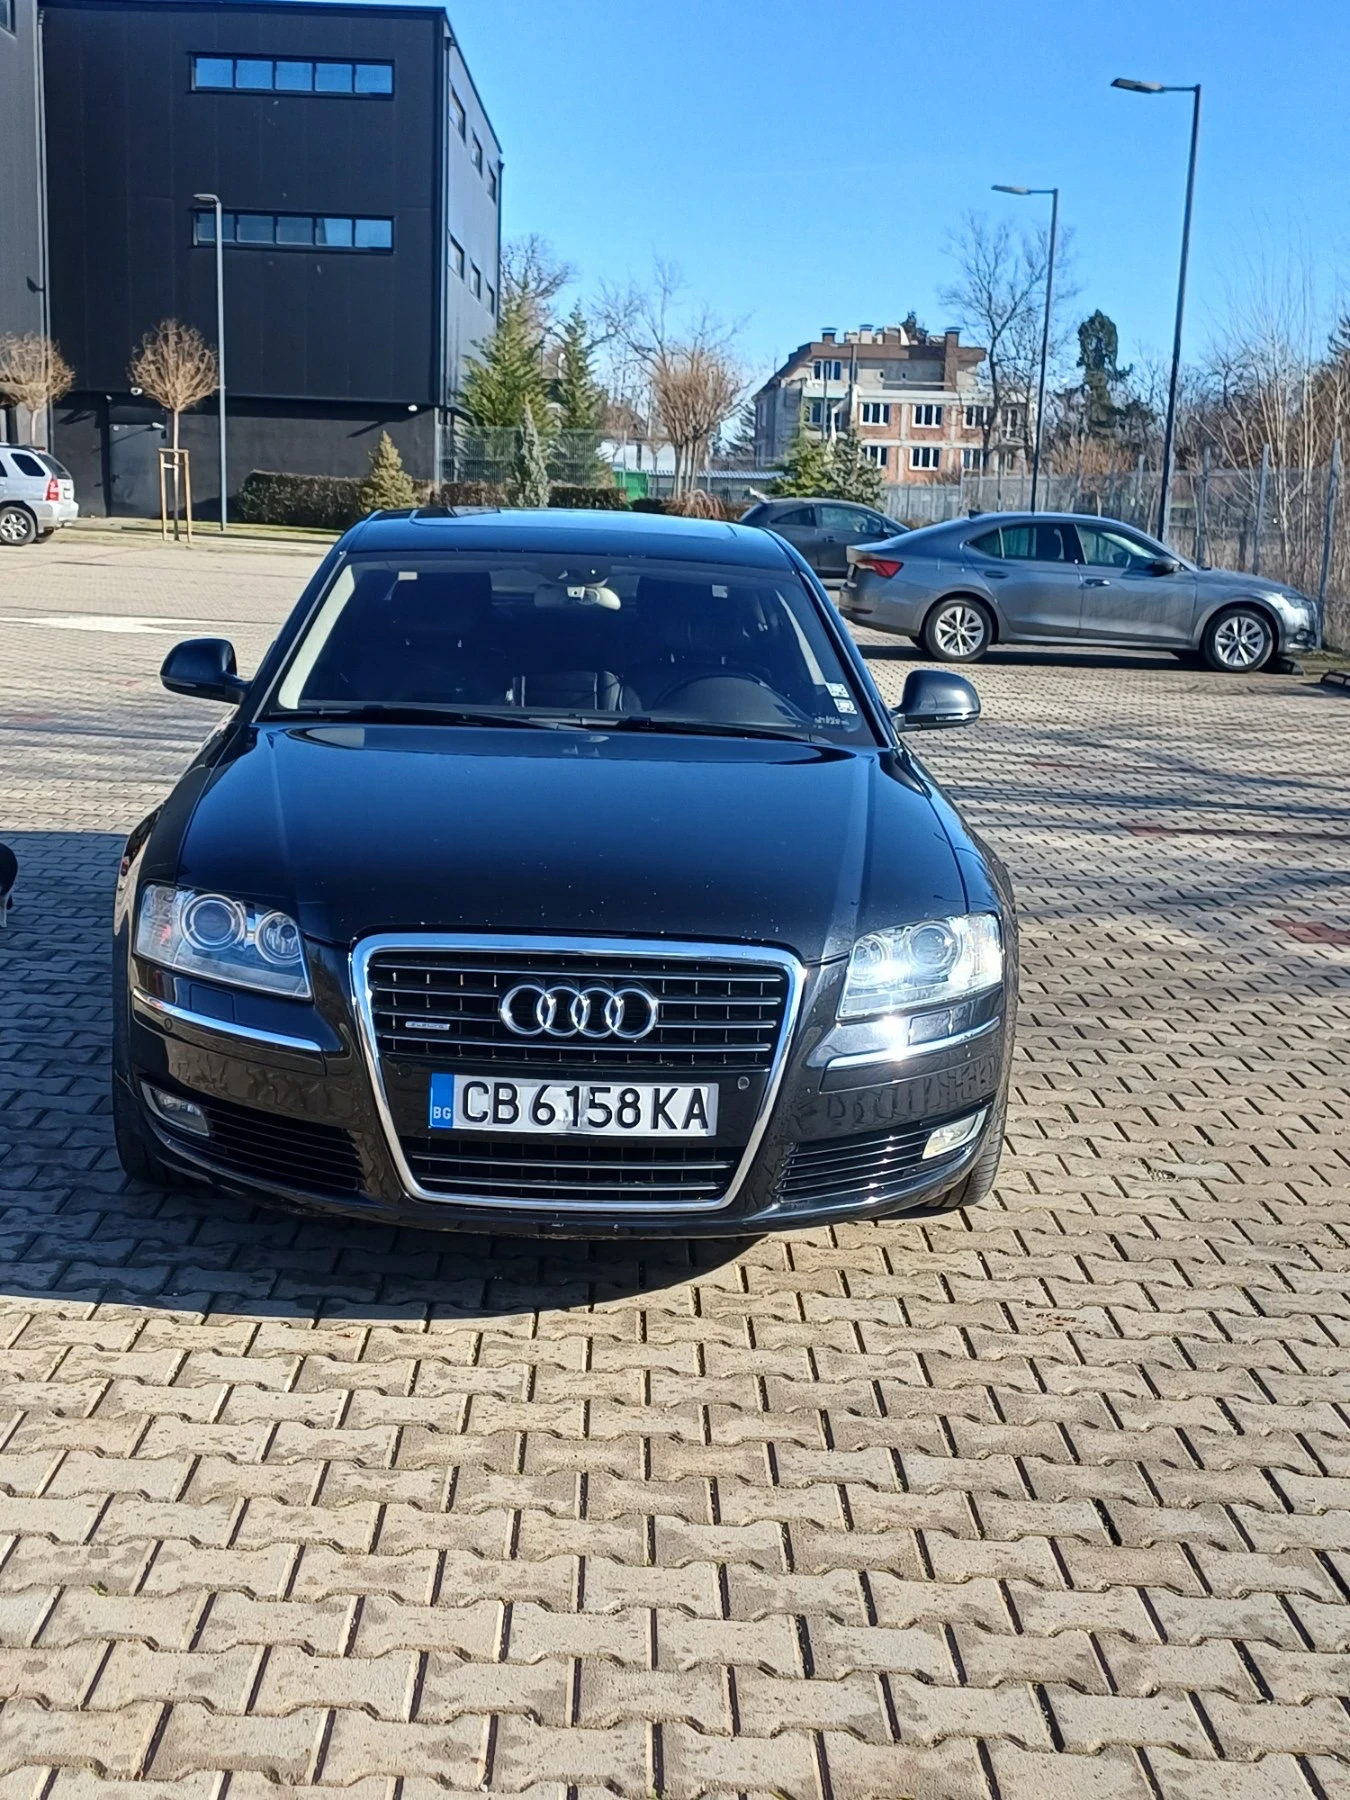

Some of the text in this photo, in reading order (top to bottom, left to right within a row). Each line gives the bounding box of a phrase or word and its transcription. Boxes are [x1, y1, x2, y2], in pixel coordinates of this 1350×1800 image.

[433, 1106, 452, 1120] BG
[462, 1080, 709, 1130] CB 6158 KA
